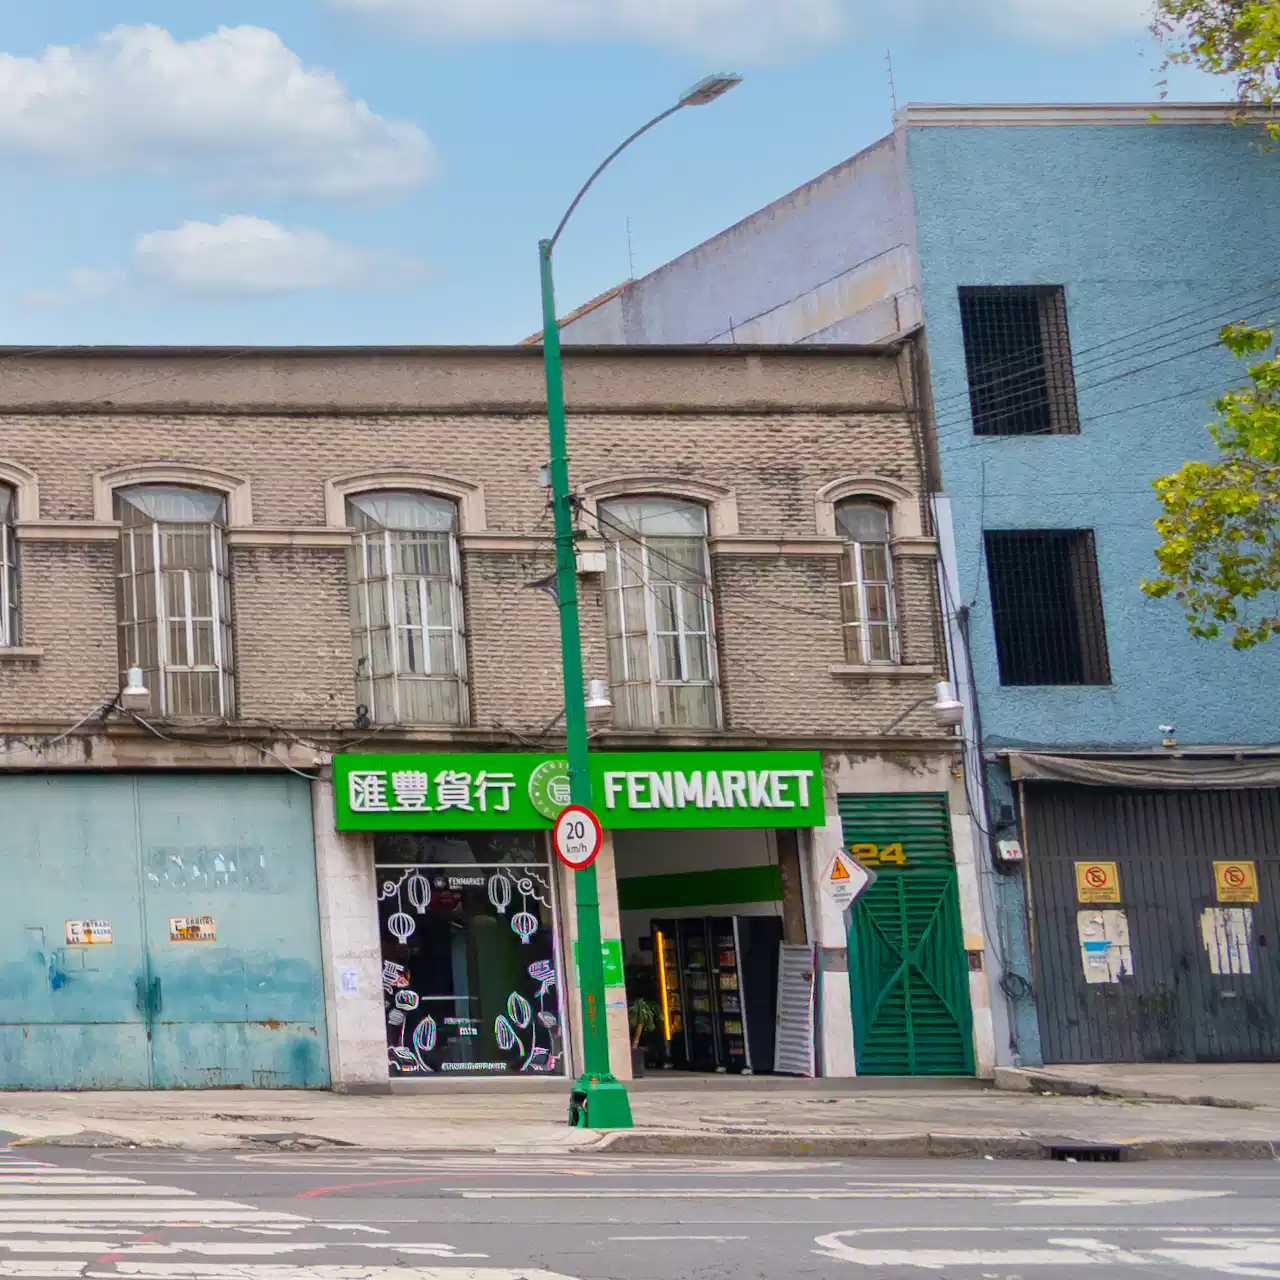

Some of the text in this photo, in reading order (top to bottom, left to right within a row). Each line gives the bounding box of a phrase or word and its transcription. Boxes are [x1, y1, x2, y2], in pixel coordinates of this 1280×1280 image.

[347, 769, 517, 812] 匯豐貨行
[603, 770, 814, 809] FENMARKET
[566, 821, 585, 840] 20
[566, 842, 588, 853] km/h
[851, 843, 907, 866] 24
